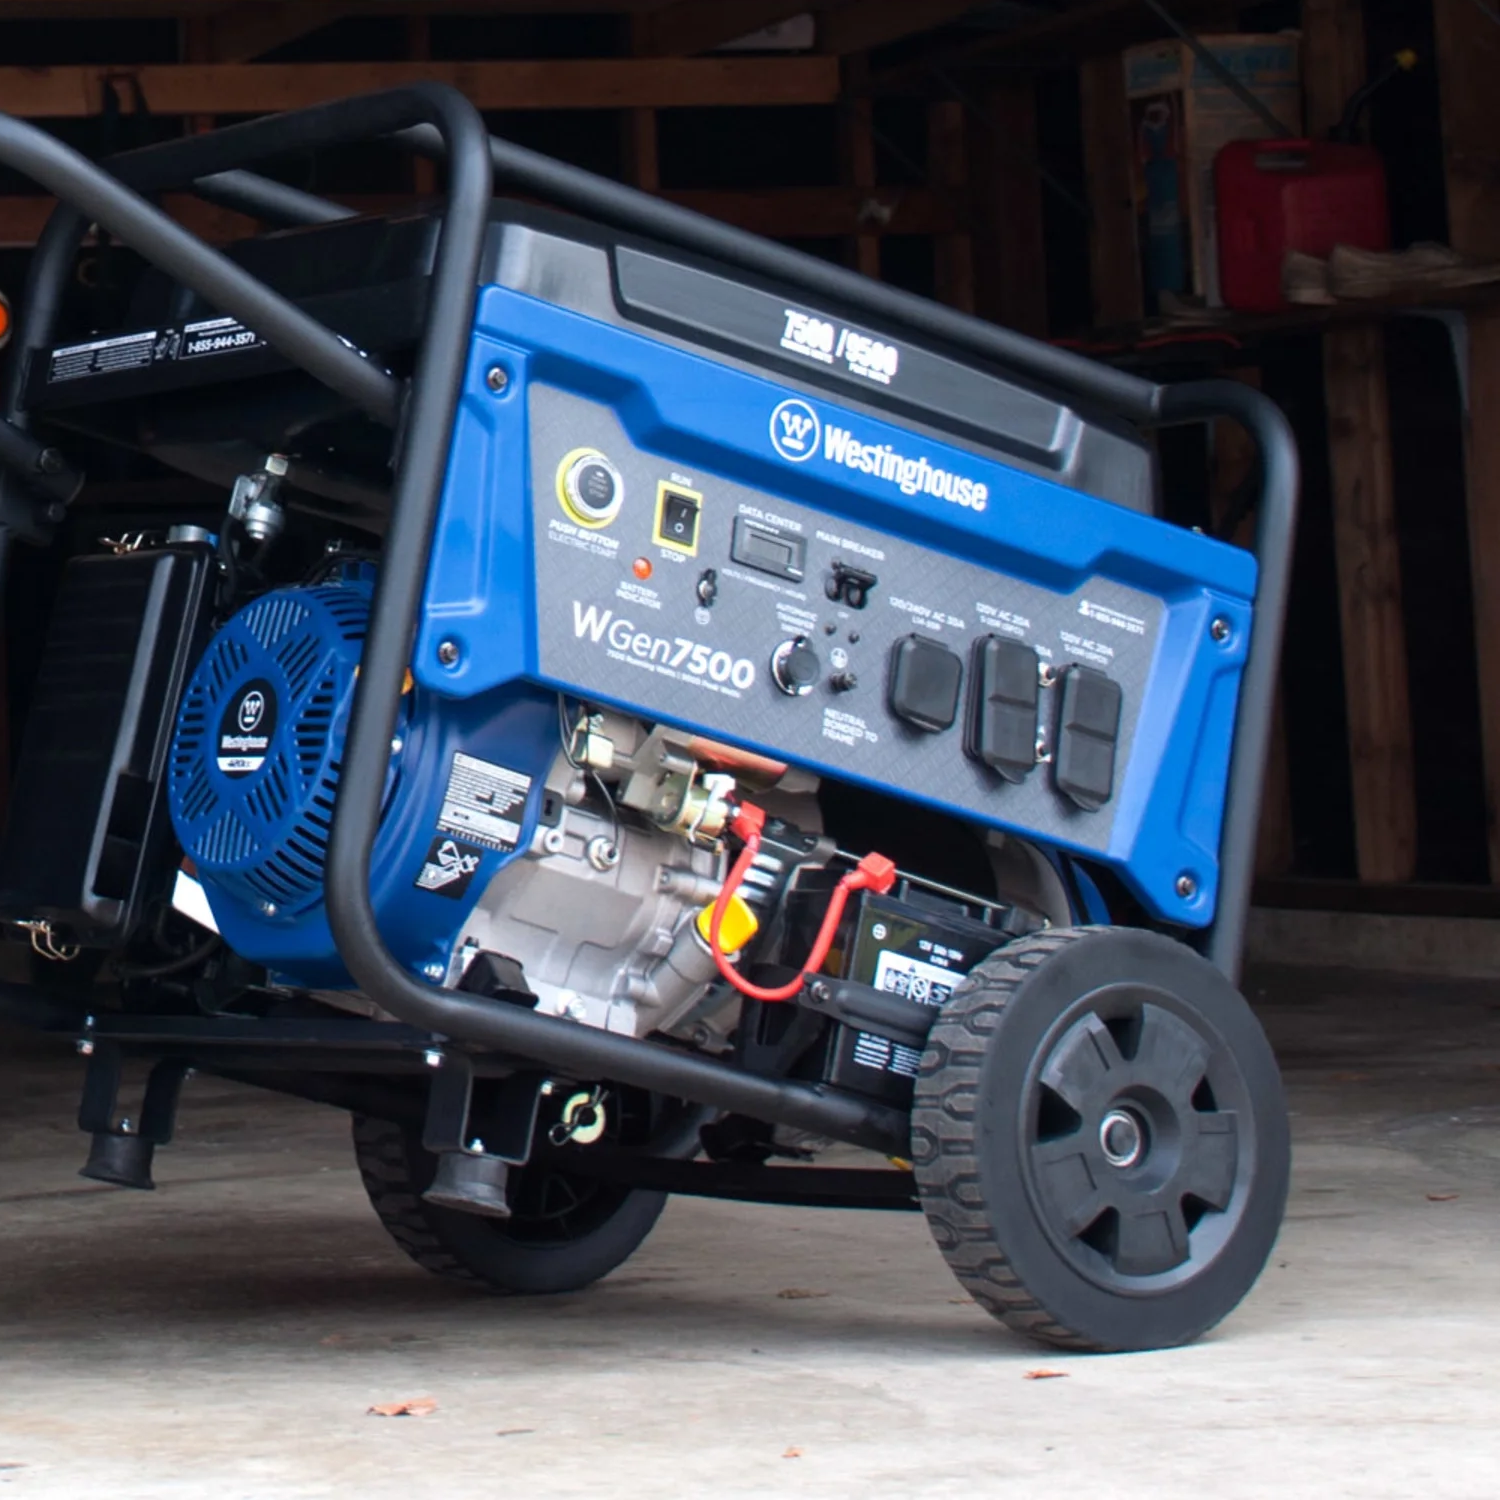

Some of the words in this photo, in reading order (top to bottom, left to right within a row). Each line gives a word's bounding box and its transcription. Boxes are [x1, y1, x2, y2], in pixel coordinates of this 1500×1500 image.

[784, 309, 834, 353] 7500
[670, 472, 693, 487] RUN
[824, 424, 989, 512] Westinghouse
[738, 503, 766, 520] DATA
[766, 513, 803, 531] CENTER
[548, 519, 577, 535] PUSH
[577, 529, 621, 550] BUTTON
[815, 530, 842, 546] MAIN
[841, 538, 886, 561] BREAKER
[660, 549, 687, 563] STOP
[615, 589, 662, 609] INDICATOR
[620, 581, 659, 598] BATTERY
[572, 600, 756, 689] WGen7500
[823, 717, 863, 738] BONDED
[864, 731, 879, 743] TO
[824, 707, 867, 729] NEUTRAL
[822, 727, 856, 746] FRAME
